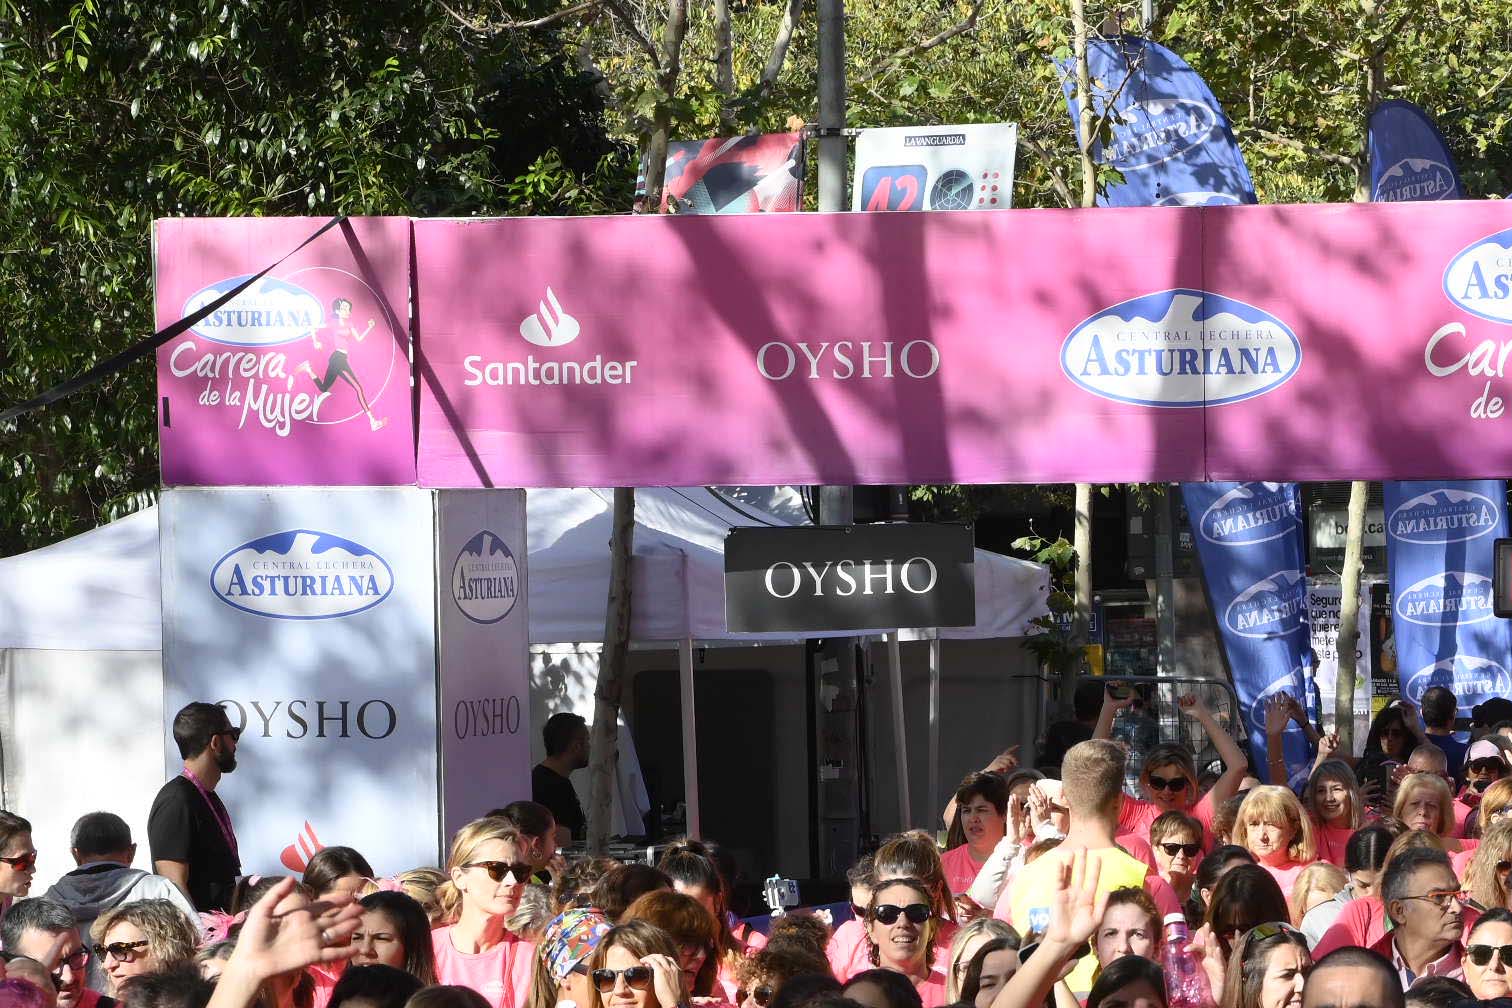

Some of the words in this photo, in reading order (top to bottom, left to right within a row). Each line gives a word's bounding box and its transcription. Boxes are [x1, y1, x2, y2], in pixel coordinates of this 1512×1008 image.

[195, 299, 313, 329] ASTURIANA
[170, 341, 288, 378] Carrera
[463, 354, 638, 387] Santander
[755, 338, 941, 381] OYSHO
[1078, 334, 1283, 378] ASTURIANA
[198, 385, 222, 406] de
[223, 380, 241, 408] la
[238, 378, 331, 437] Mujer
[1469, 383, 1505, 420] de
[224, 562, 382, 598] ASTURIANA
[457, 571, 515, 602] ASTURIANA
[764, 555, 939, 599] OYSHO
[454, 694, 521, 742] OYSHO
